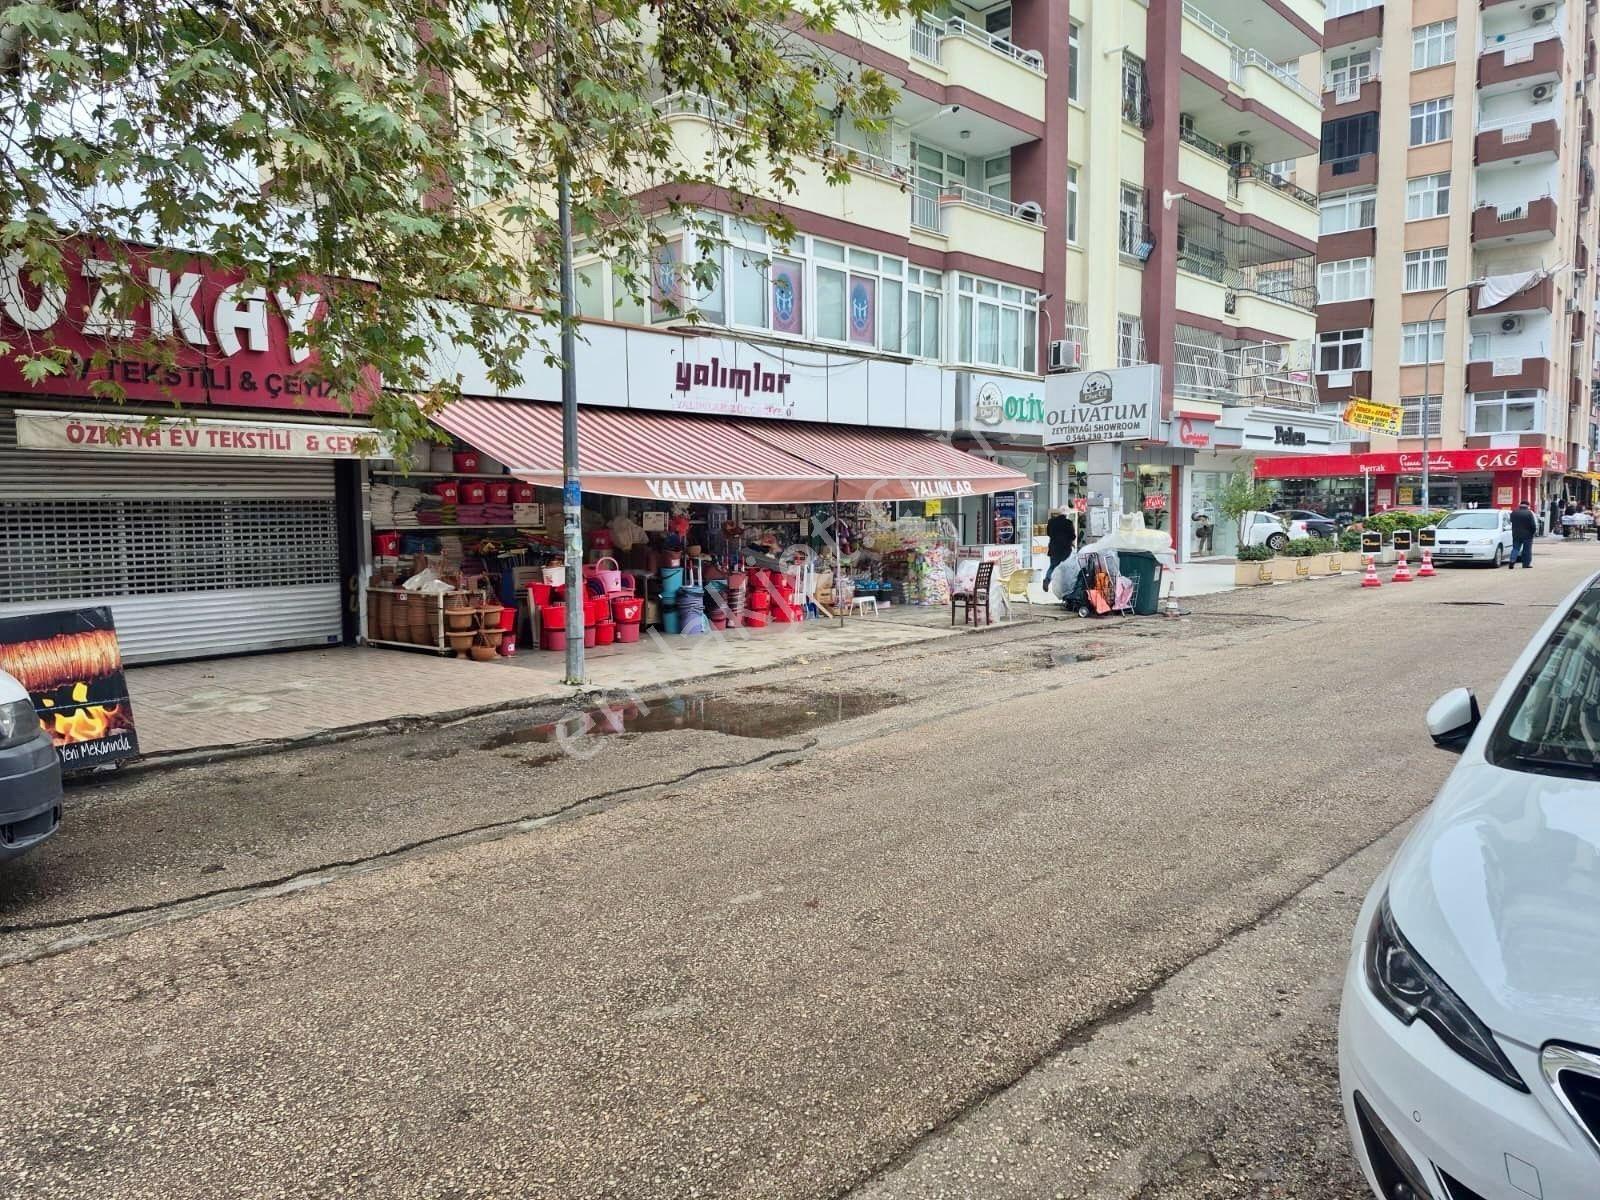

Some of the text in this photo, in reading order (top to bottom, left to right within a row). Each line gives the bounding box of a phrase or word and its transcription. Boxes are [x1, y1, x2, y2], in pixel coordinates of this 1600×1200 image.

[239, 371, 258, 392] &
[675, 357, 791, 397] yalımlar
[1046, 403, 1148, 426] OLİVATUM
[1094, 422, 1141, 432] SHOWROOM
[170, 428, 200, 447] EV
[206, 428, 291, 451] TEKSTİLİ
[306, 435, 320, 451] &
[326, 436, 377, 455] ÇEY
[1360, 464, 1385, 472] Berrak
[1476, 450, 1518, 470] ÇAĞ
[646, 480, 747, 501] YALIMLAR
[911, 481, 976, 498] YALIMLAR
[59, 744, 79, 763] Yeni
